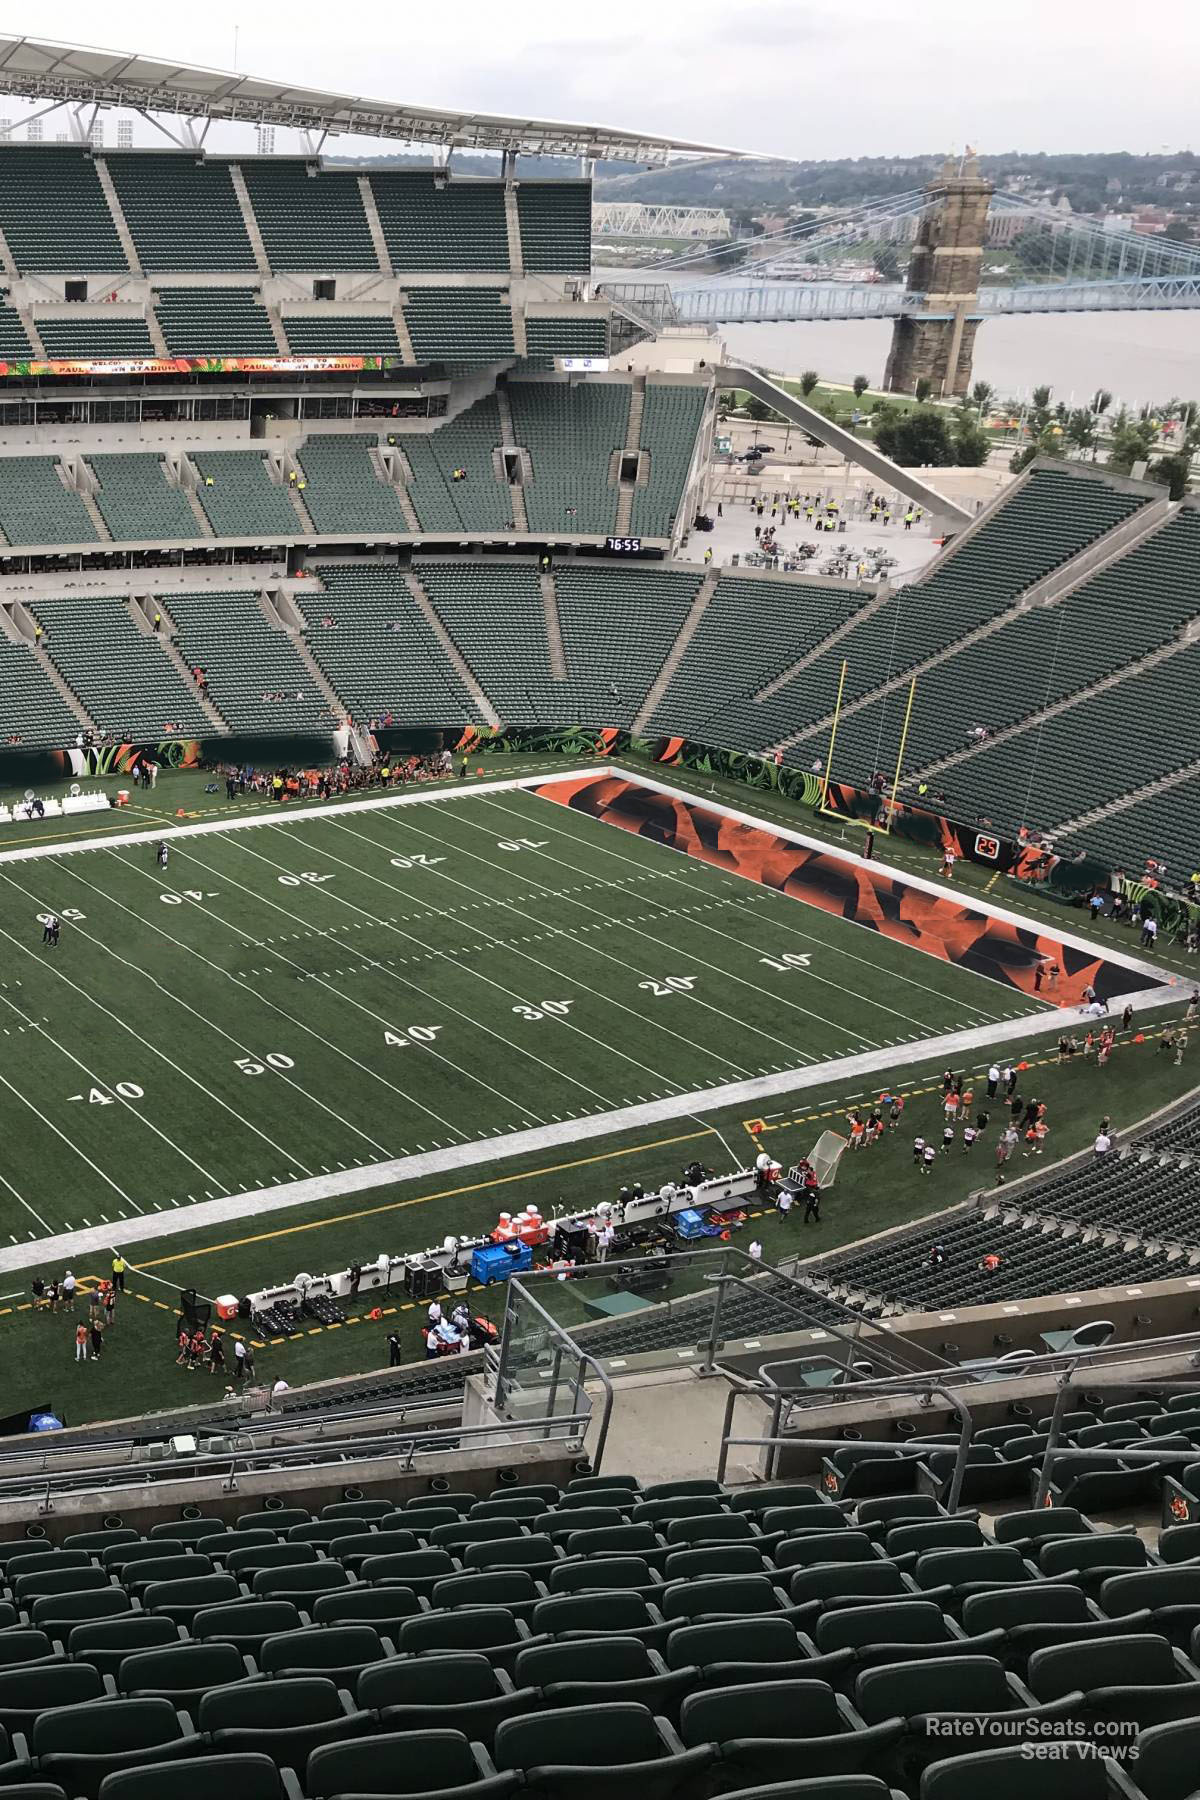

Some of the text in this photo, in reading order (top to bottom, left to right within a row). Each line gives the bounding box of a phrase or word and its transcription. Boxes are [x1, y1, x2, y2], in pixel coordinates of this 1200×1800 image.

[608, 538, 639, 551] 76:55
[497, 838, 541, 851] 10
[979, 838, 995, 855] 25
[389, 854, 437, 868] 20
[277, 872, 325, 886] 30
[159, 889, 202, 904] 40
[759, 953, 810, 971] 10
[638, 976, 694, 996] 20
[512, 1000, 569, 1020] 30
[384, 1026, 436, 1047] 40
[233, 1053, 294, 1075] 50
[88, 1082, 144, 1105] 40
